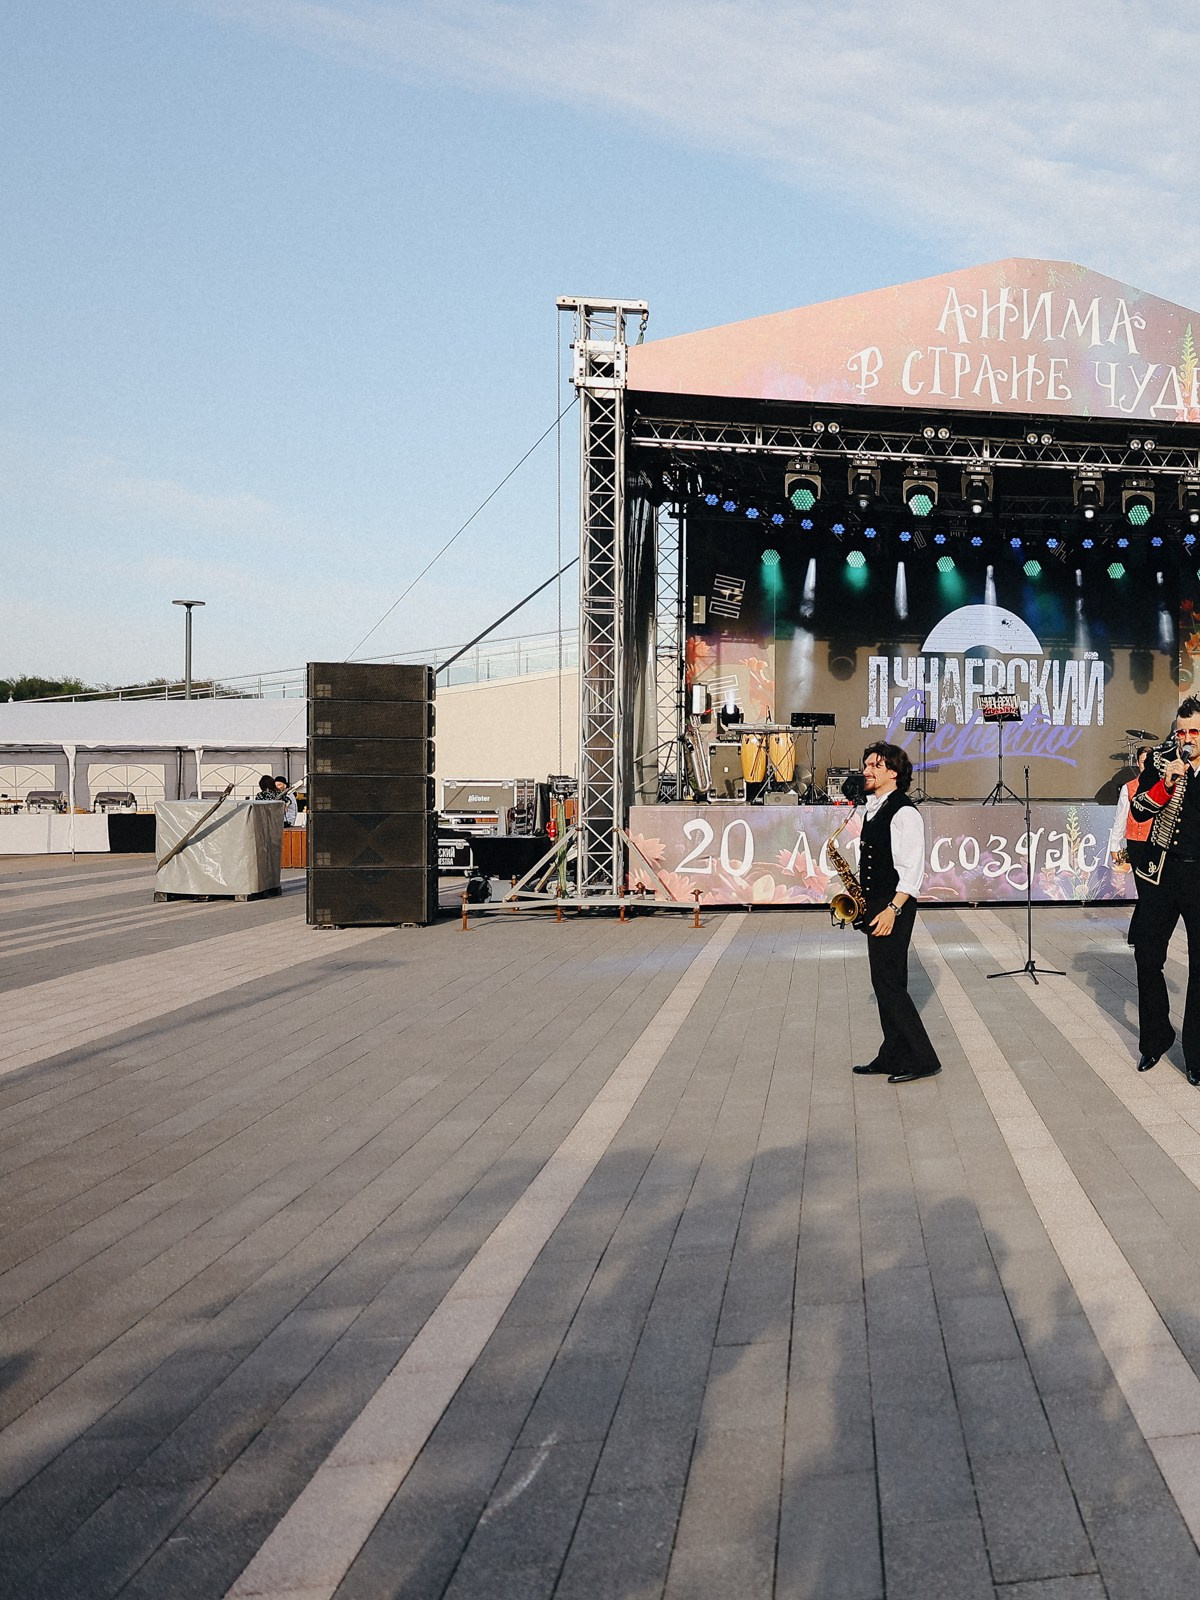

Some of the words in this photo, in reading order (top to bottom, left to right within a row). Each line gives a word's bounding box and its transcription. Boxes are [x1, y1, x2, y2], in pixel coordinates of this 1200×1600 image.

[935, 286, 1147, 354] АНИМА
[847, 346, 884, 396] В
[901, 346, 1073, 405] СТРАНЕ
[860, 653, 1105, 728] ДУНАЕВСКИЙ
[674, 818, 755, 880] 20
[930, 826, 1113, 891] создае
